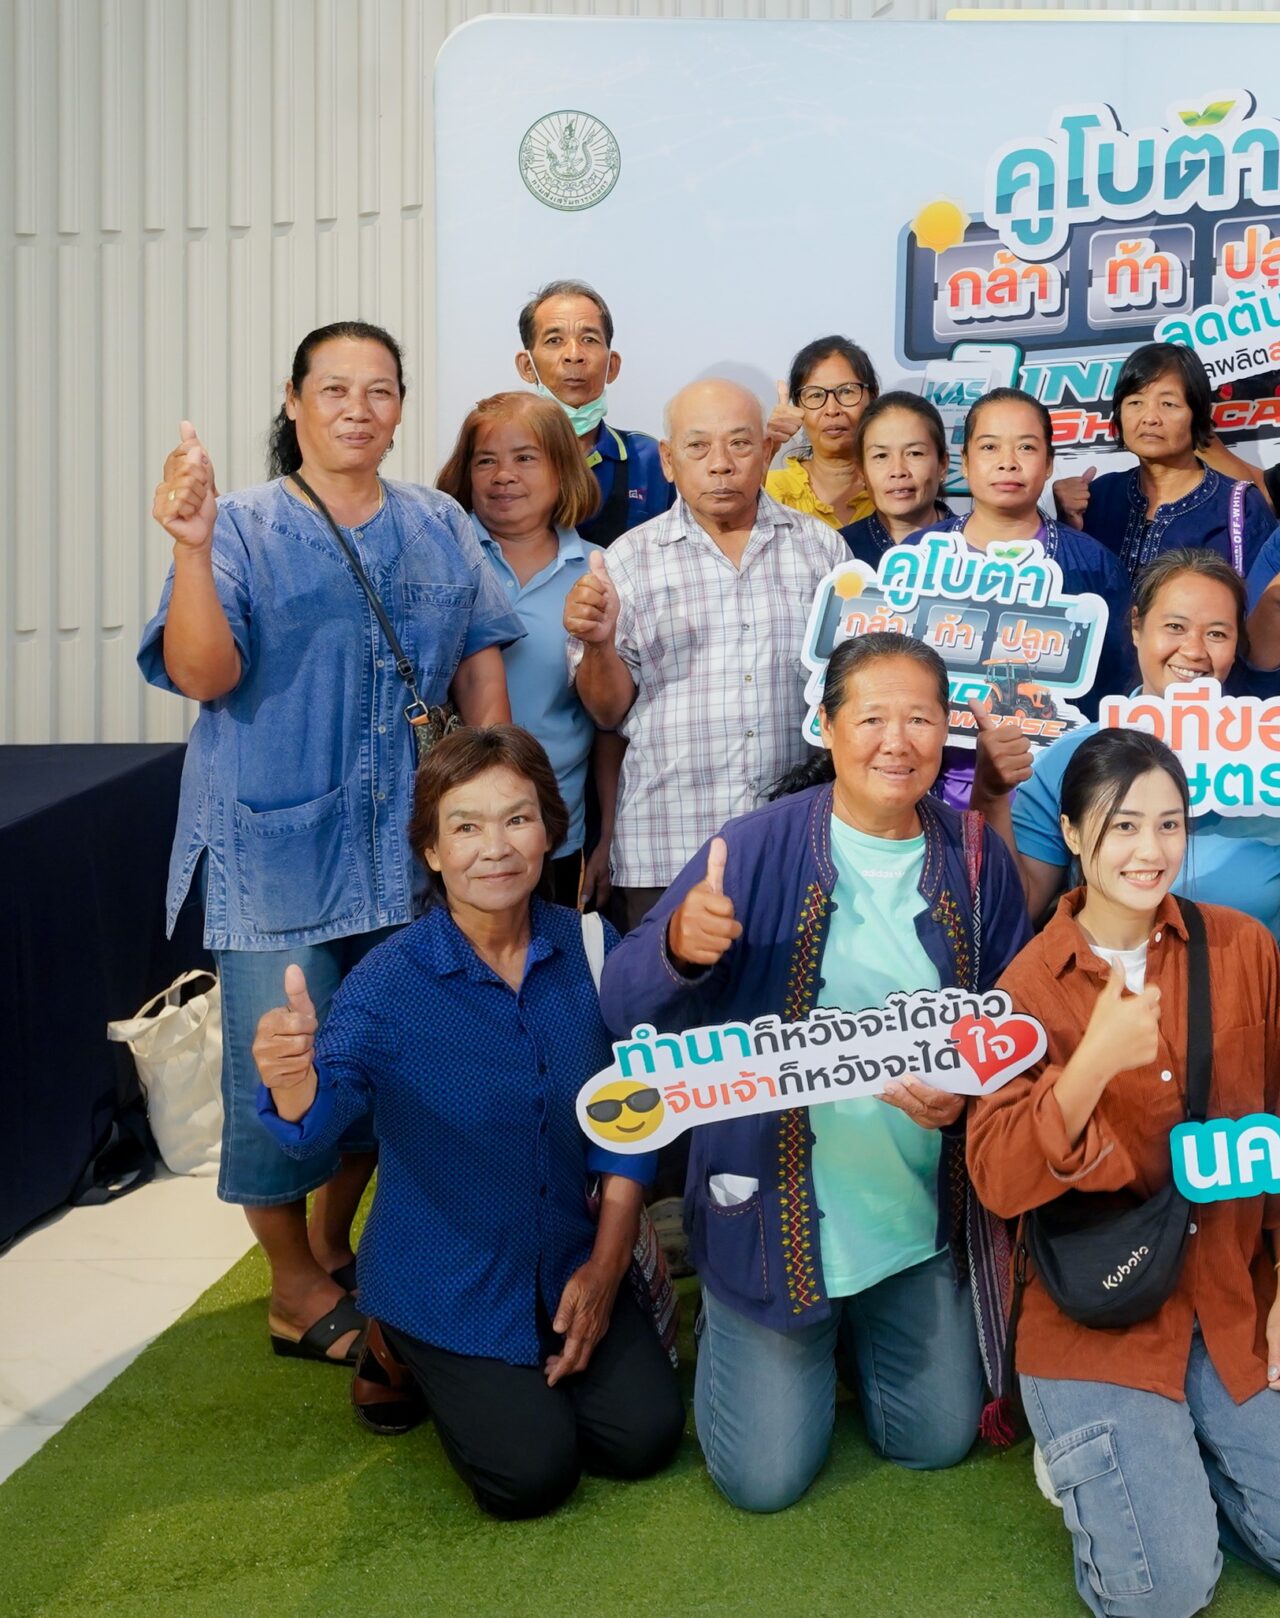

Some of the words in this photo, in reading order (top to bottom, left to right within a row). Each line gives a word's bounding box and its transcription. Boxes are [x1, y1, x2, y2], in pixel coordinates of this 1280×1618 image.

[949, 251, 1048, 308] กล้า
[1107, 241, 1170, 295] ท้า
[935, 614, 975, 649] ท้า
[1002, 618, 1064, 663] ปลูก
[617, 993, 1006, 1077] ทำนาก็หวังจะได้ข้าว
[1102, 1245, 1150, 1290] Kubota
